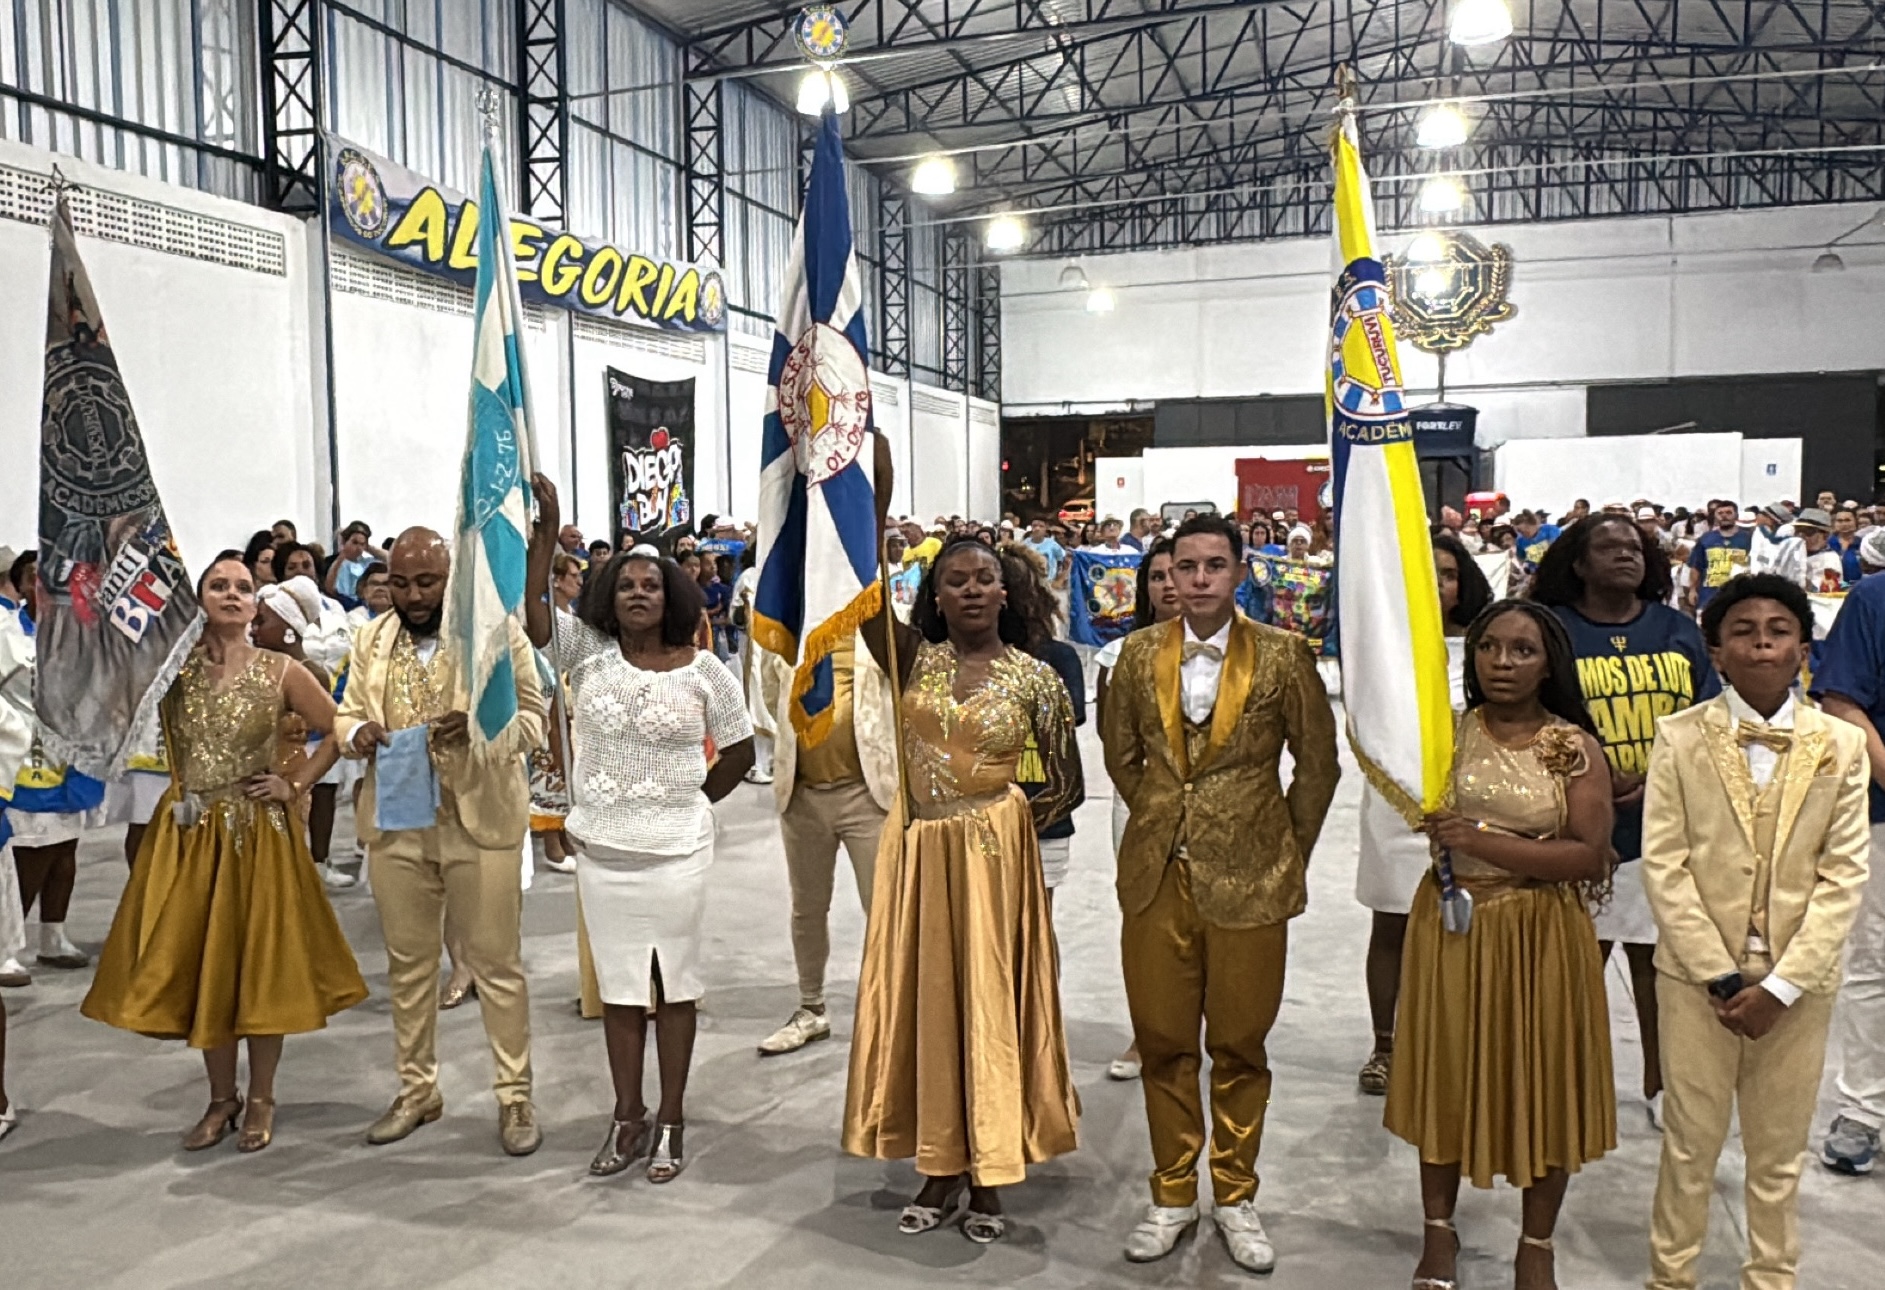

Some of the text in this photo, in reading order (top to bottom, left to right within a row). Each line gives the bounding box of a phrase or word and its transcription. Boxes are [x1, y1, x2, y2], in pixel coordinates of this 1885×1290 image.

[1363, 316, 1395, 384] TUCURUVI
[1338, 421, 1413, 441] ACADÊM
[624, 444, 682, 494] DIEGO
[1575, 655, 1628, 699] MOS
[1624, 654, 1658, 692] DE
